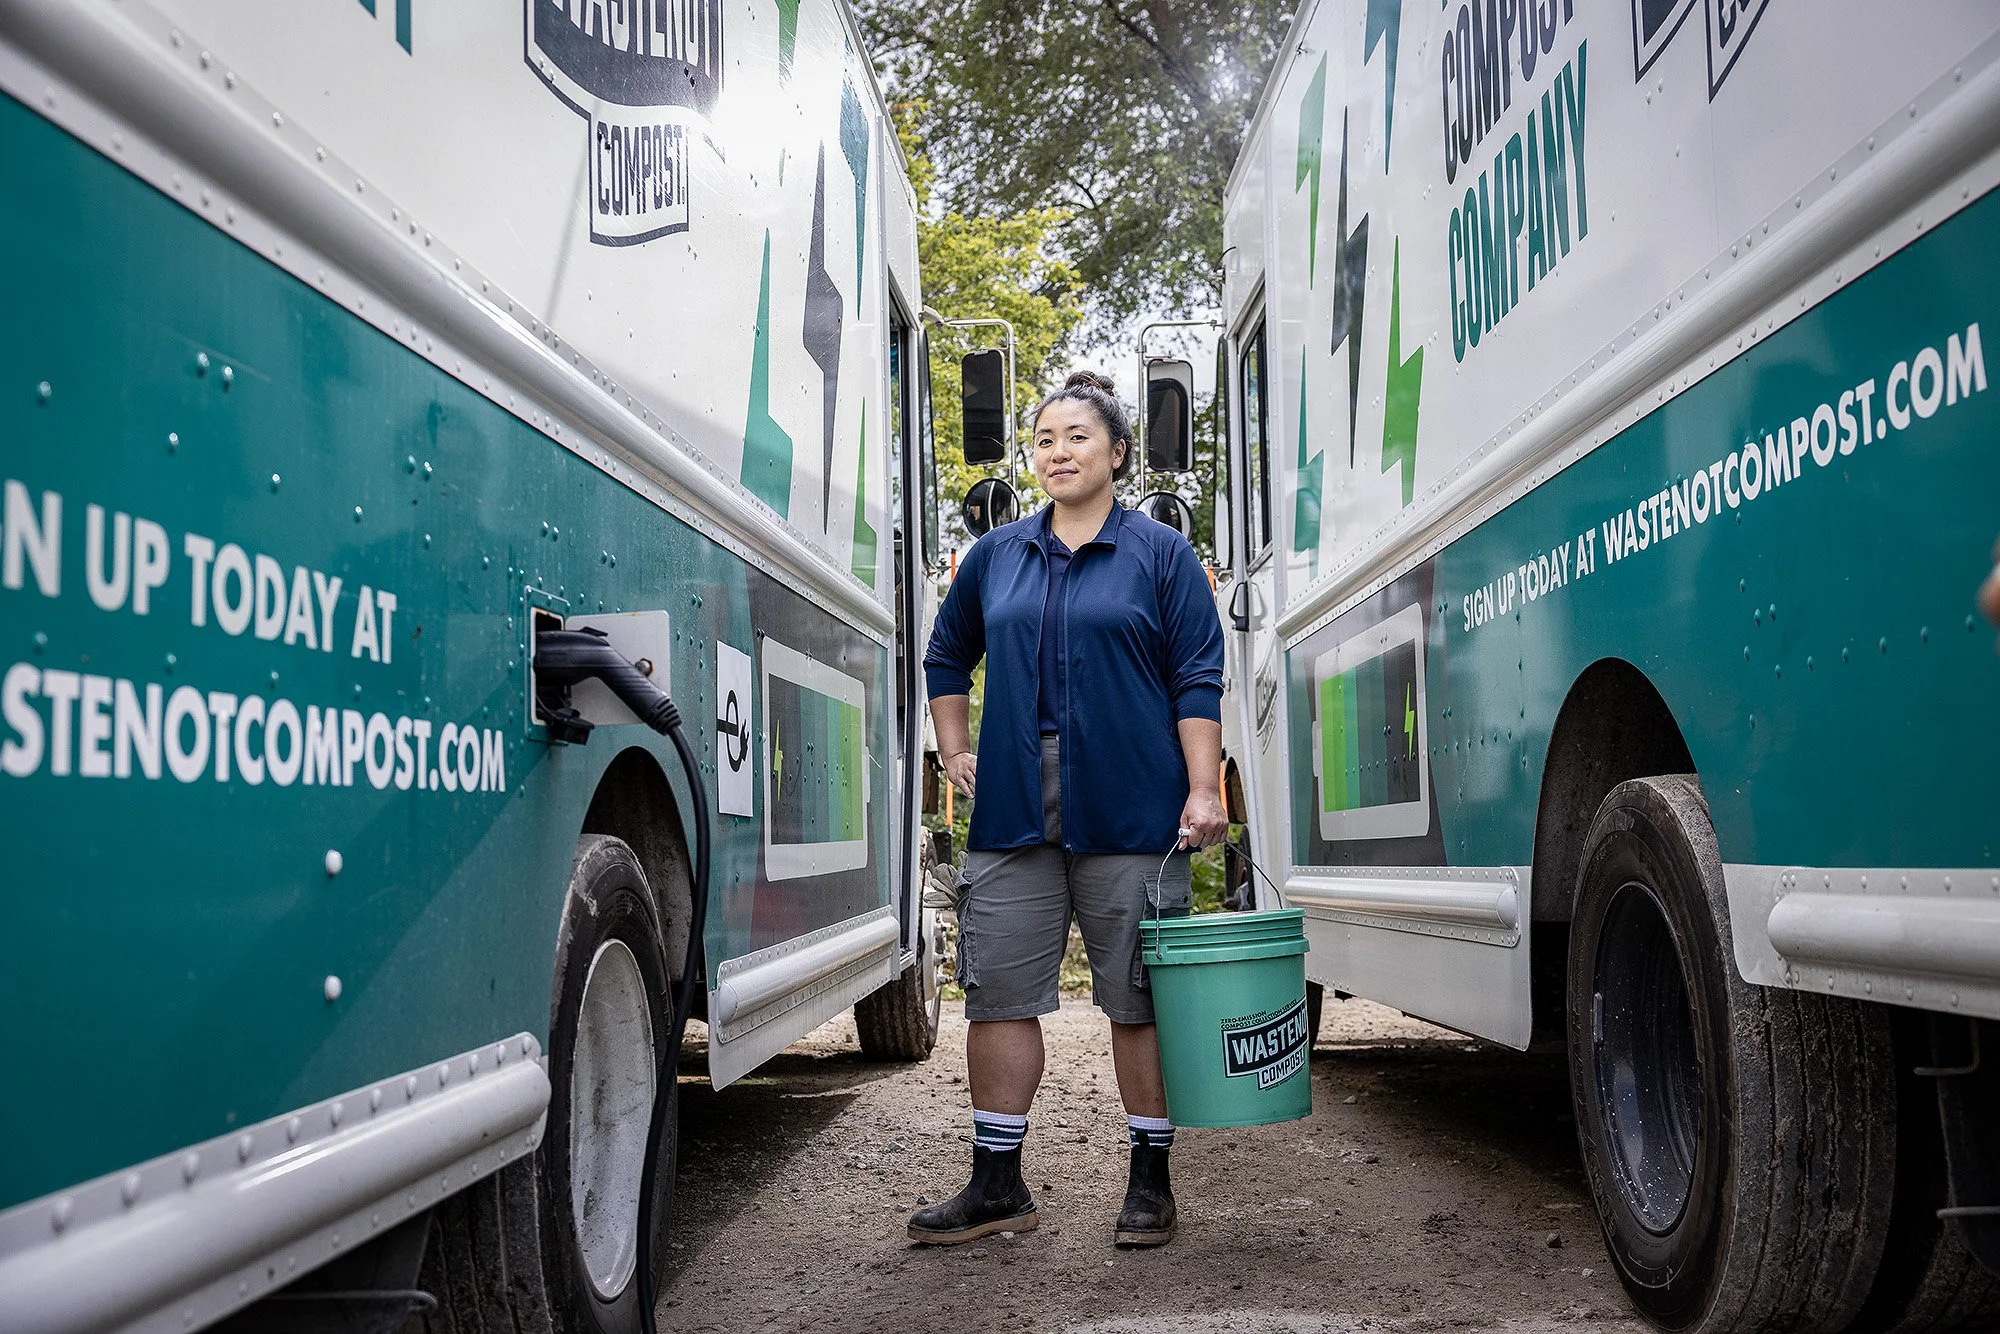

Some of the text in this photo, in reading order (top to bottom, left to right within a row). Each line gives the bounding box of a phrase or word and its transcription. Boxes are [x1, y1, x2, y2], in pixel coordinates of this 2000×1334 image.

[1448, 37, 1588, 364] COMPANY
[85, 502, 171, 616] UP
[184, 531, 344, 653] TODAY
[350, 584, 397, 665] AT
[1463, 322, 1988, 632] SIGN UP TODAY AT WASTENOTCOMPOST.COM
[1261, 1047, 1304, 1085] COMPOST
